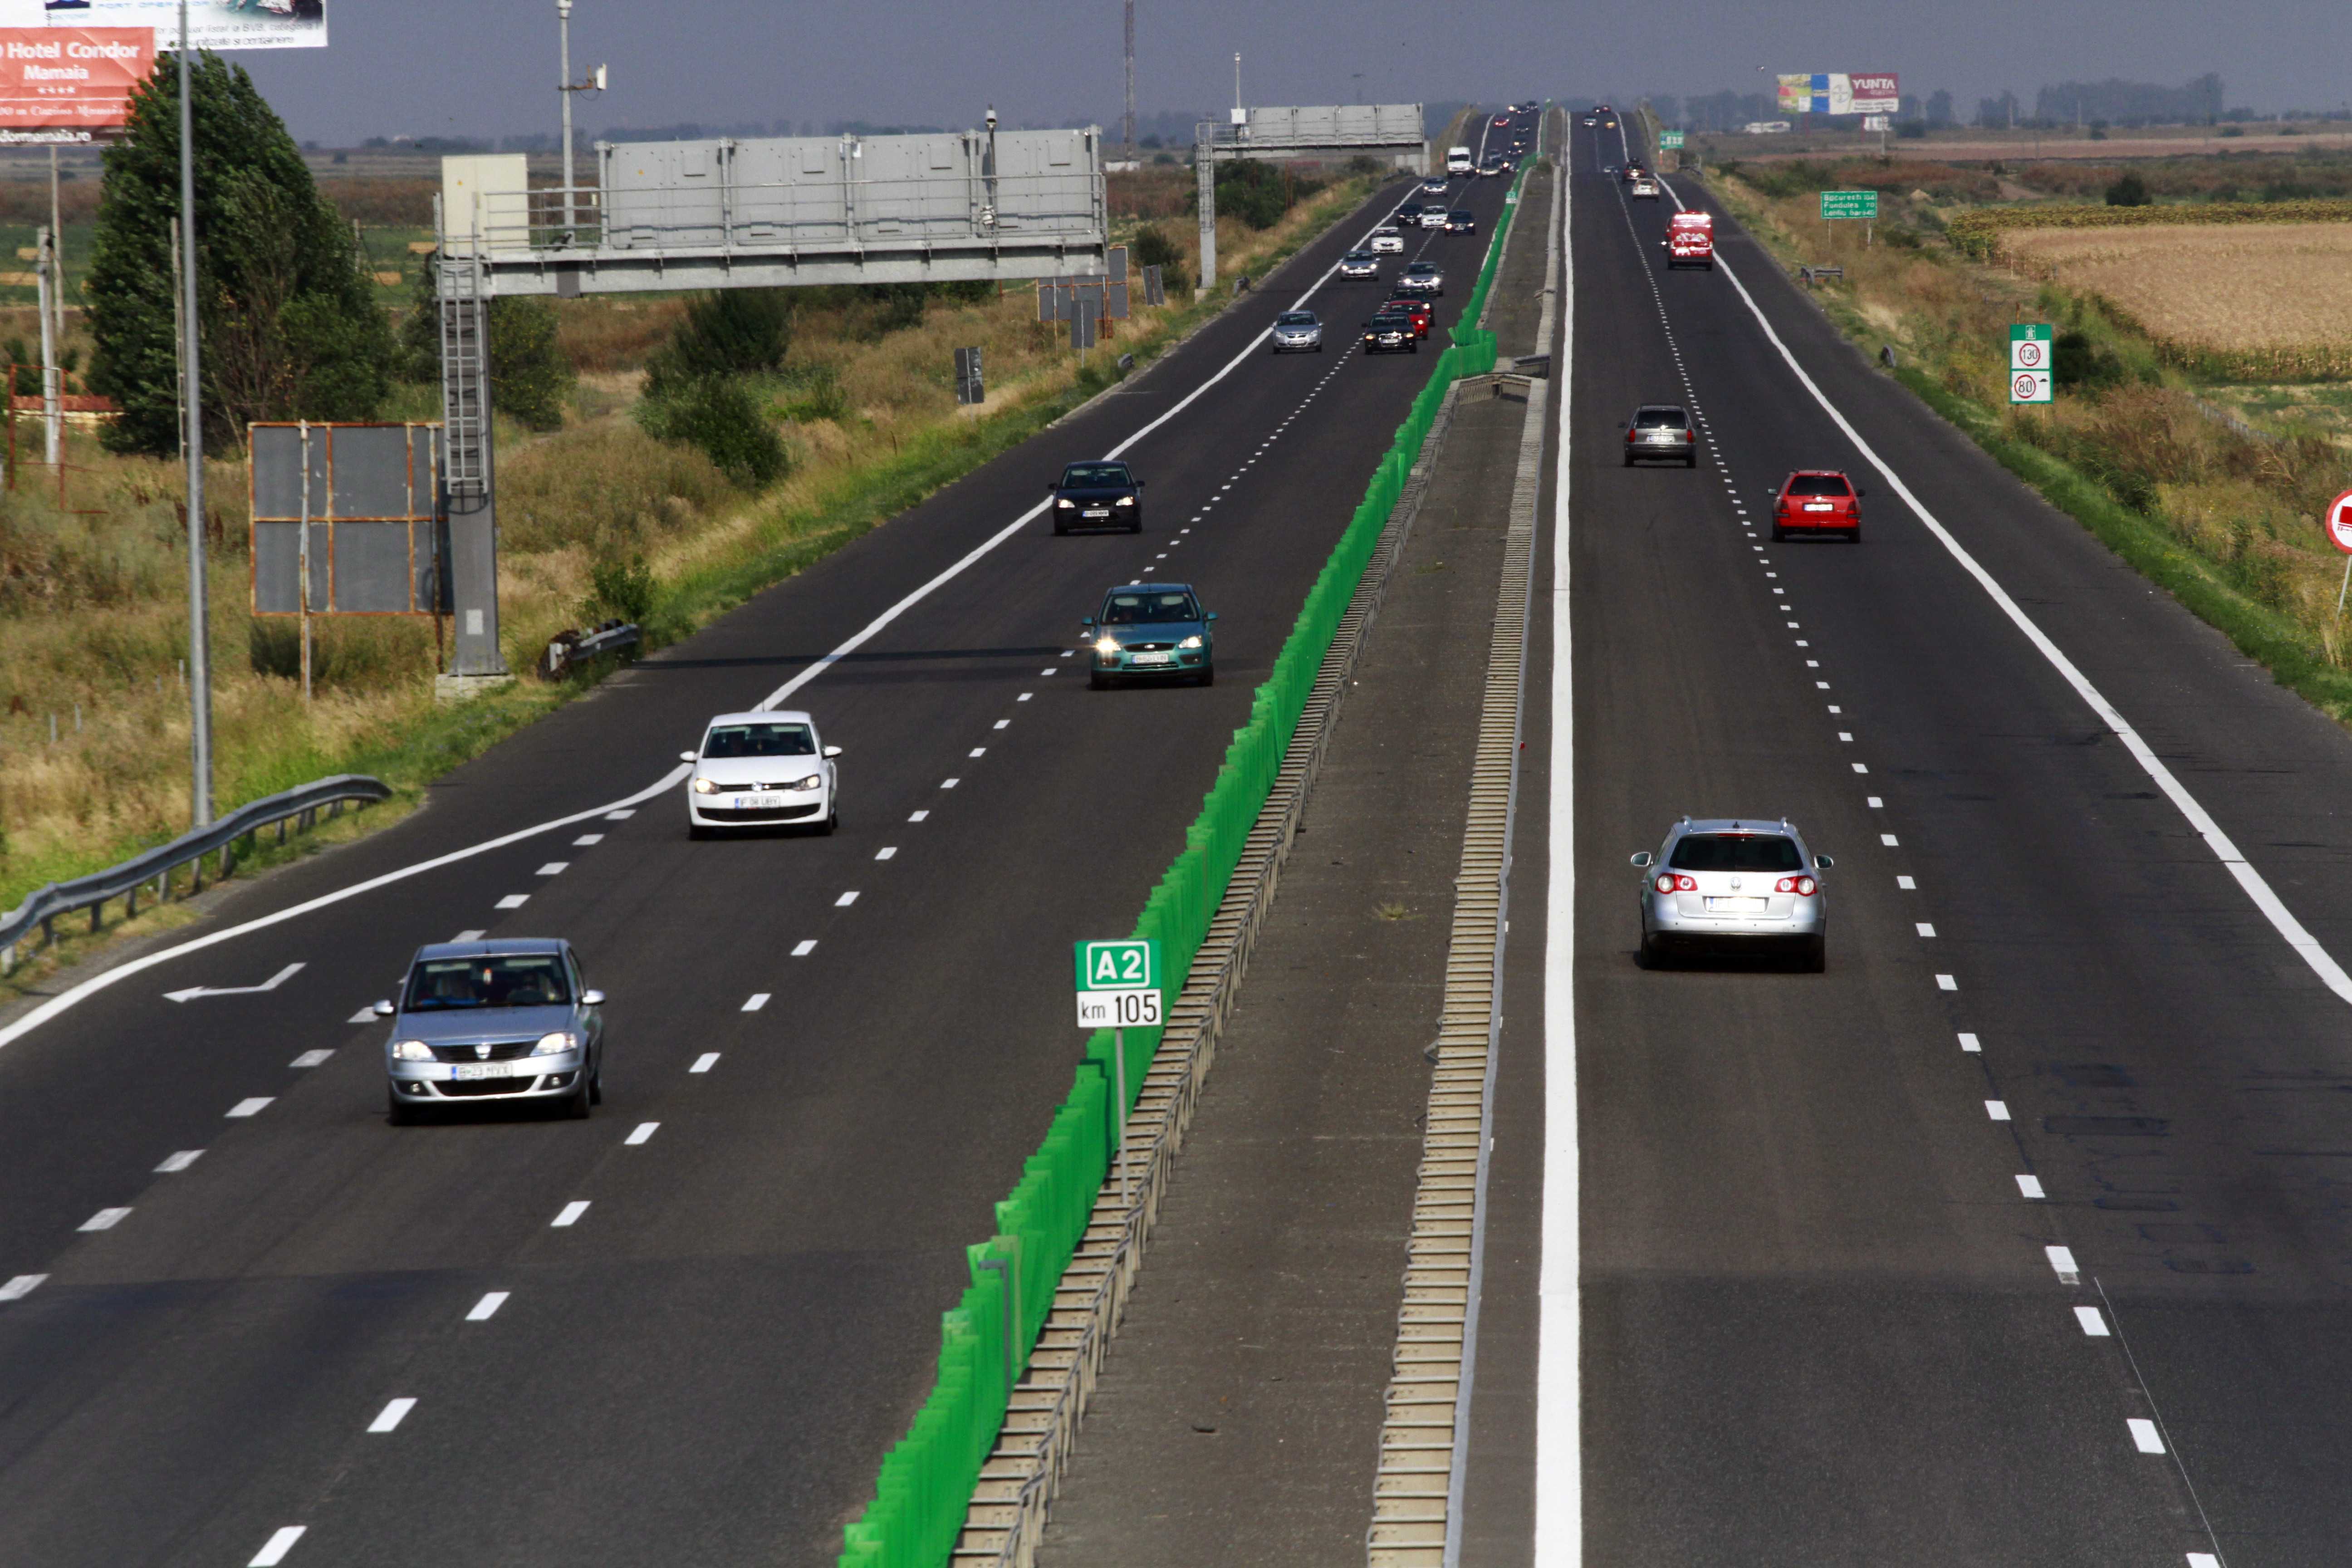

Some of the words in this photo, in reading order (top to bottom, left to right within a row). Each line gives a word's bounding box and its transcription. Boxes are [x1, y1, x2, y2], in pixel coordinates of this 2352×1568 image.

[7, 41, 61, 59] Hotel
[67, 41, 140, 58] Condor
[24, 64, 89, 80] Mamaia
[1852, 78, 1896, 89] YUNTA
[2023, 349, 2038, 360] 130
[2018, 380, 2033, 393] 80
[1095, 949, 1142, 980] A2
[1082, 1000, 1106, 1020] km
[1115, 994, 1157, 1023] 105
